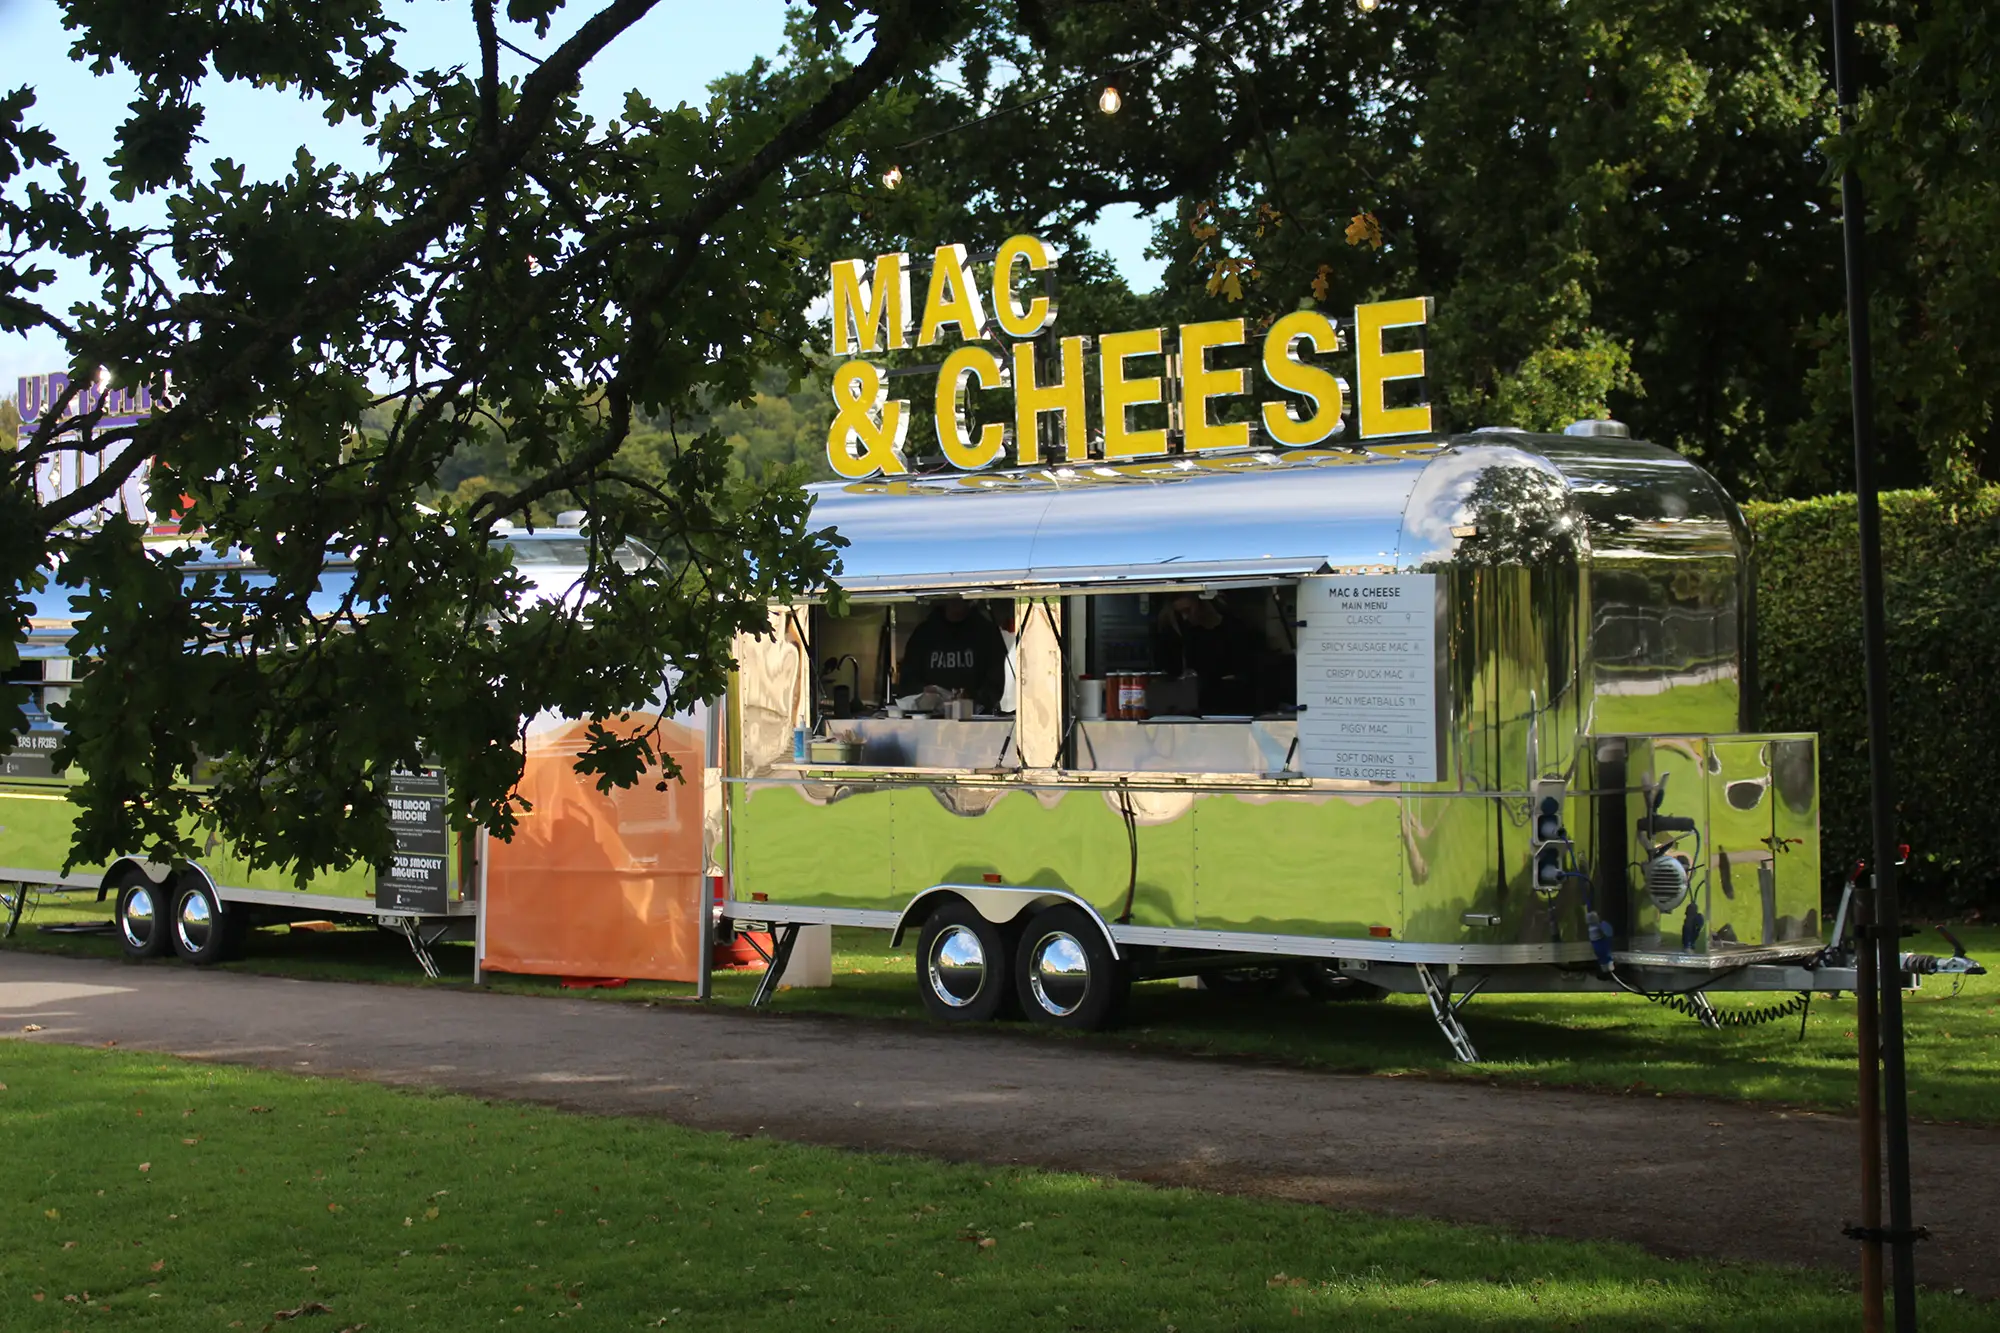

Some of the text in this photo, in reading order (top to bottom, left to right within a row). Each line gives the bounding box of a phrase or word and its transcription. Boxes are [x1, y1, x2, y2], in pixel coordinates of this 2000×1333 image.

[831, 233, 1058, 356] MAC
[826, 297, 1434, 479] & CHEESE
[1329, 588, 1401, 597] MAC & CHEESE
[1341, 602, 1388, 610] MAIN MENU
[1346, 615, 1382, 625] CLASSIC
[1321, 643, 1345, 651] SPICY
[1347, 643, 1387, 651] SAUSAGE
[1389, 643, 1409, 652] MAC
[930, 650, 974, 669] PABLO
[1326, 669, 1355, 678] CRISPY
[1357, 669, 1382, 679] DUCK
[1384, 670, 1404, 679] MAC
[1354, 697, 1405, 707] MEATBALLS
[1341, 724, 1367, 733] PIGGY
[1369, 725, 1389, 734] MAC
[1336, 753, 1359, 763] SOFT
[1361, 754, 1395, 764] DRINKS
[1334, 767, 1351, 777] TEA
[1353, 768, 1360, 777] &
[1362, 769, 1397, 779] COFFEE
[403, 800, 431, 811] BACON
[392, 810, 427, 822] BRIOCHE
[410, 858, 442, 870] SMOKEY
[391, 867, 429, 880] BAGUETTE
